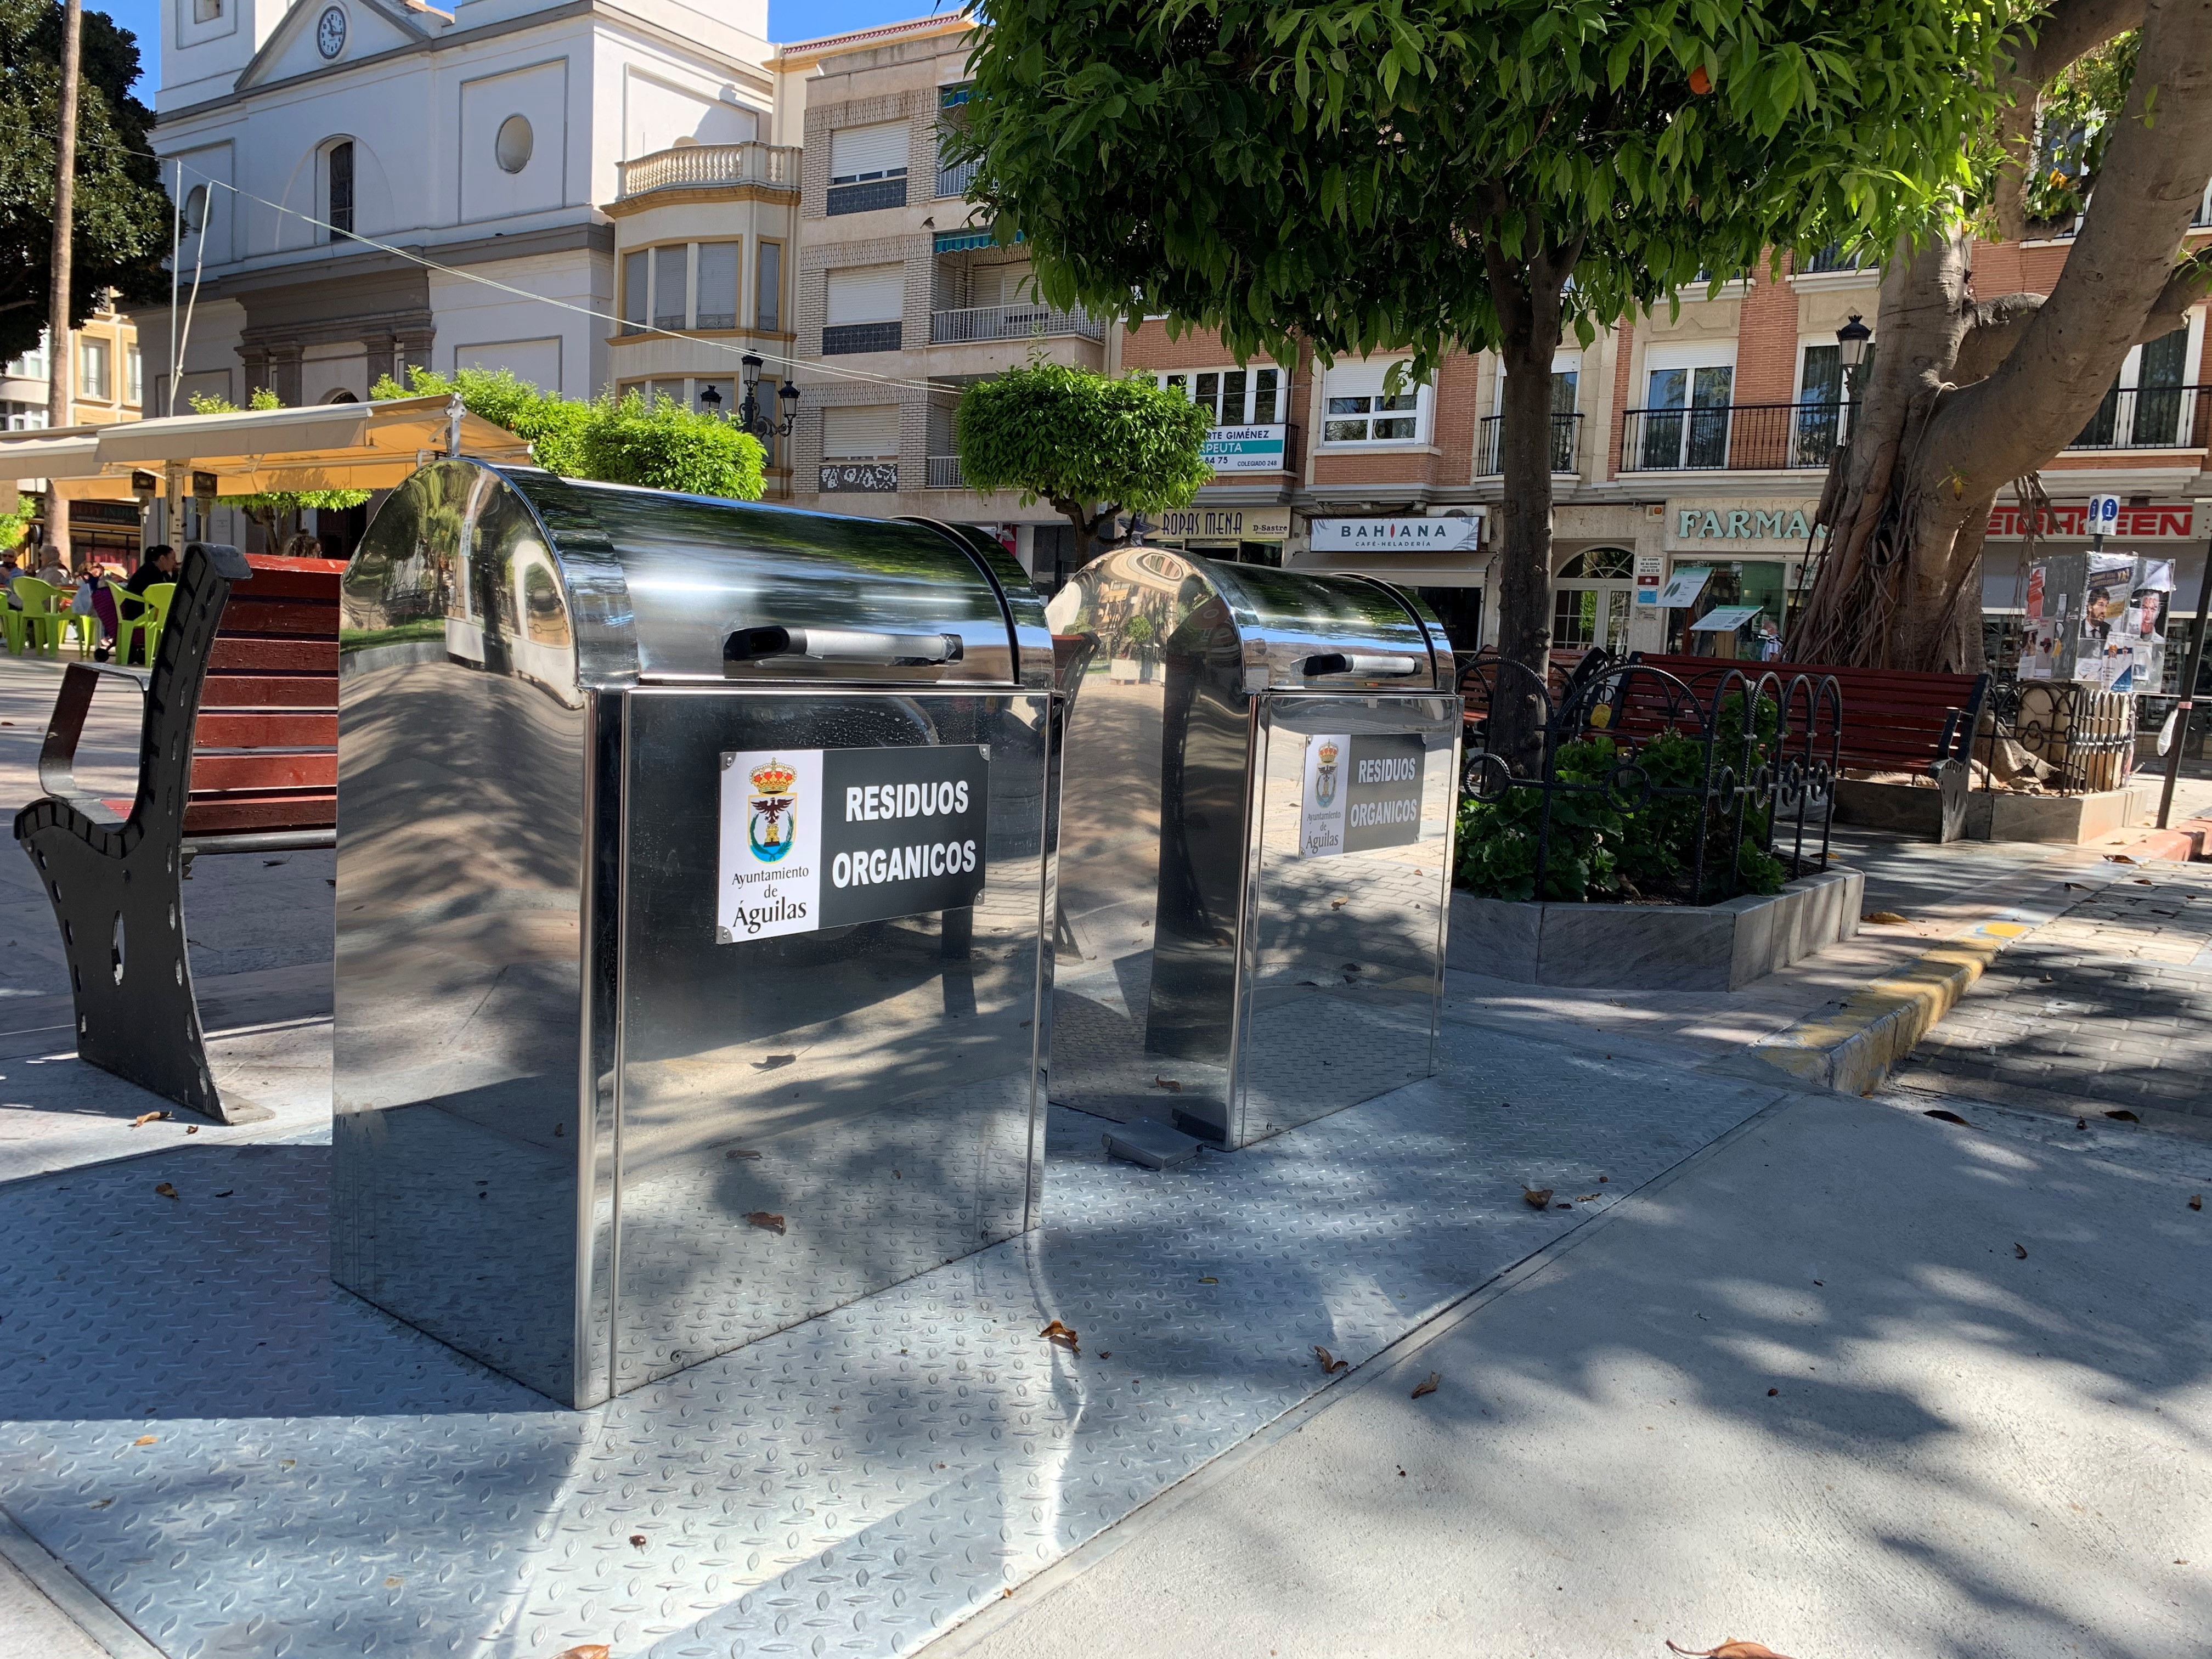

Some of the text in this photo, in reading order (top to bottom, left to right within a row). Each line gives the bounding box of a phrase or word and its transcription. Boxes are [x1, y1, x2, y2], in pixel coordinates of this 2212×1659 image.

[1226, 428, 1270, 439] GIMÉNEZ
[1161, 512, 1243, 535] ROPAS MENA
[1341, 523, 1447, 538] BAHIANA
[1986, 509, 2193, 536] EIGHEN
[1358, 757, 1416, 783] RESIDUOS
[845, 780, 969, 822] RESIDUOS
[1306, 810, 1341, 825] Ayuntamiento
[1350, 799, 1418, 828] ORGANICOS
[1319, 821, 1327, 831] de
[1306, 831, 1339, 854] Águilas
[832, 839, 977, 889] ORGANICOS
[731, 866, 809, 889] Ayuntamiento
[764, 883, 778, 898] de
[732, 896, 807, 934] Águilas
